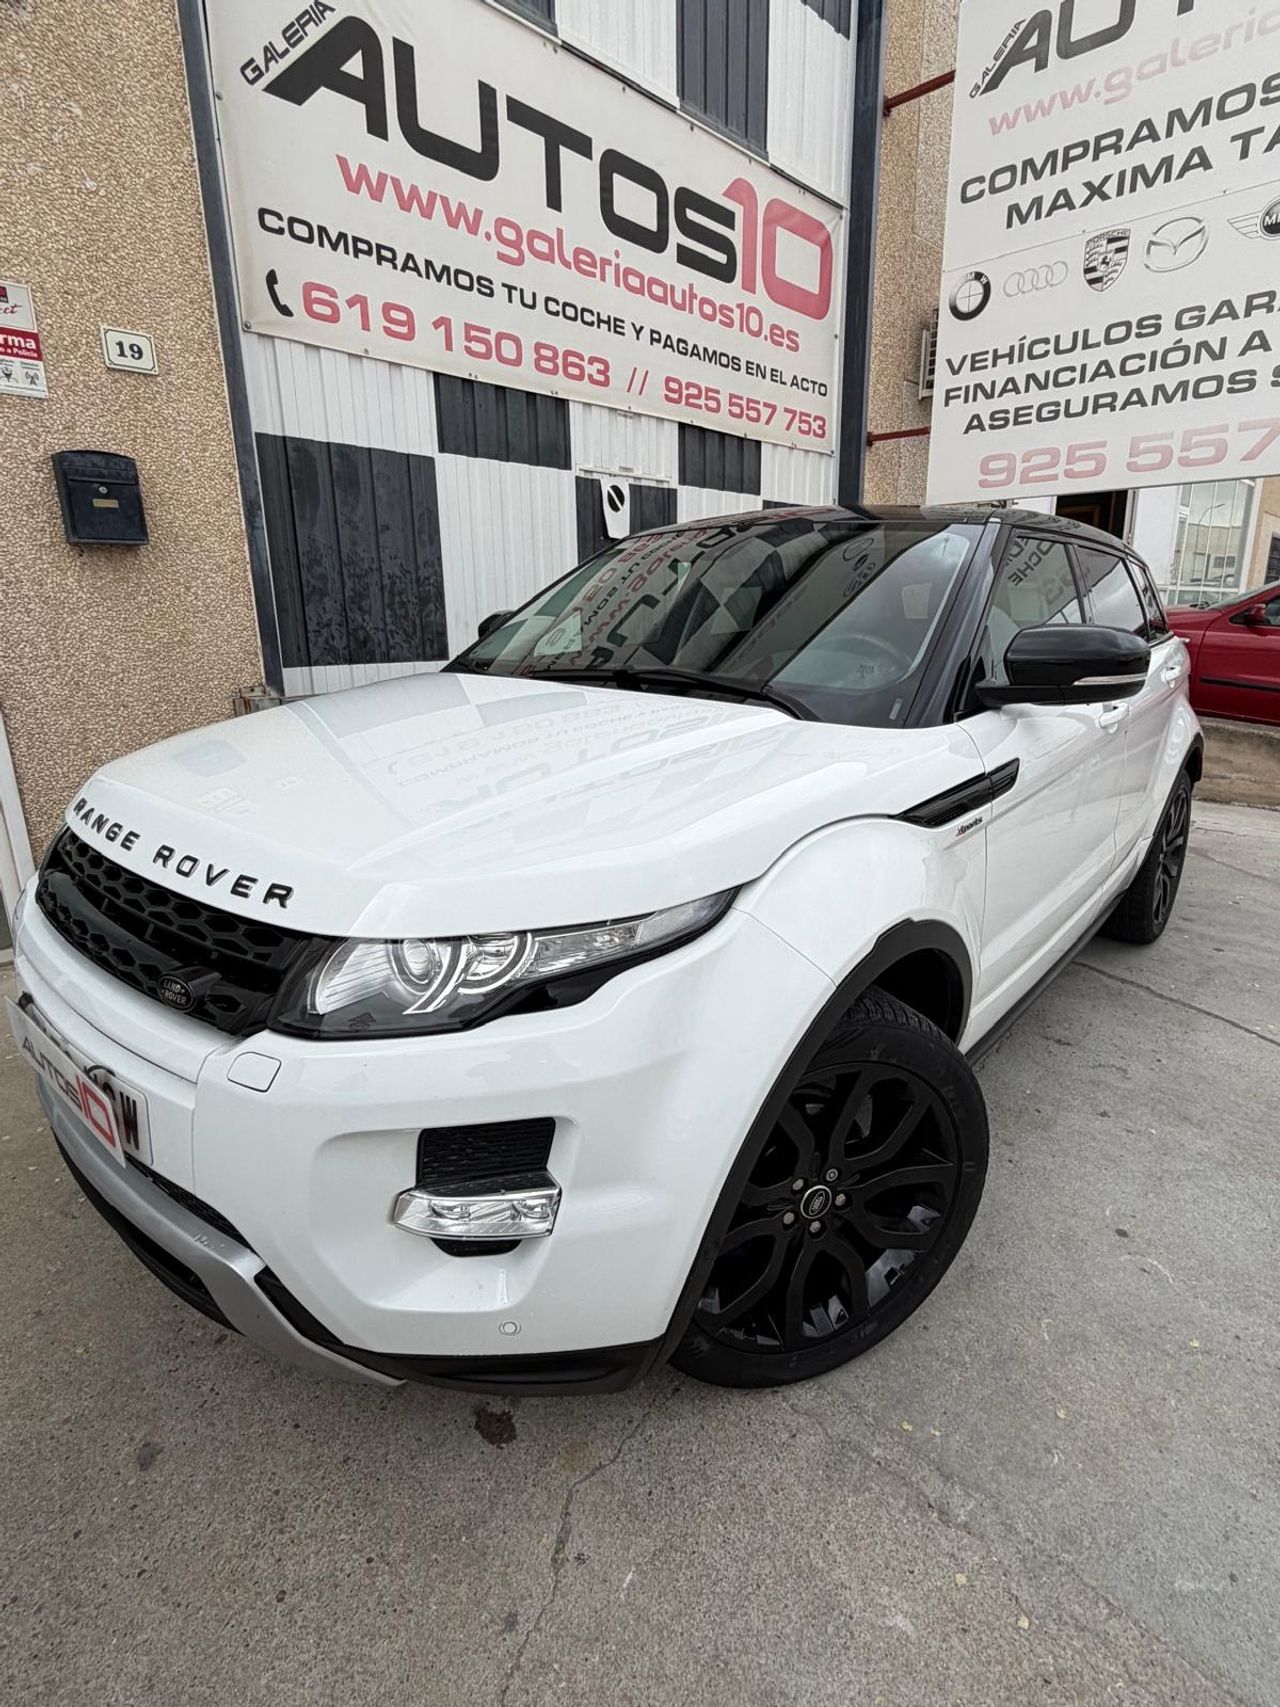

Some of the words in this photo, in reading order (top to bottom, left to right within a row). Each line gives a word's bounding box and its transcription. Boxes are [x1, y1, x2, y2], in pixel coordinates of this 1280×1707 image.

[240, 0, 336, 86] GALERIA
[969, 19, 1026, 99] GALERIA
[979, 0, 1194, 96] AU
[1005, 145, 1214, 229] MAXIMA
[335, 154, 800, 353] www.galeriaautos10.es
[257, 207, 495, 298] COMPRAMOS
[501, 282, 537, 310] TU
[544, 296, 626, 336] COCHE
[631, 322, 644, 341] Y
[650, 329, 741, 373] PAGAMOS
[745, 360, 767, 380] EN
[770, 368, 787, 386] EL
[790, 375, 828, 397] ACTO
[945, 314, 1162, 376] VEHÍCULOS
[1174, 290, 1280, 331] GAR
[115, 340, 143, 360] 19
[302, 281, 416, 341] 619
[432, 316, 523, 367] 150
[533, 341, 610, 388] 863
[664, 375, 721, 414] 925
[728, 392, 777, 426] 557
[783, 406, 827, 439] 753
[944, 336, 1228, 408] FINANCIACIÓN
[1238, 329, 1272, 357] A
[963, 369, 1258, 435] ASEGURAMOS
[978, 440, 1108, 489] 925
[73, 797, 140, 852] RANGE
[152, 844, 295, 909] ROVER
